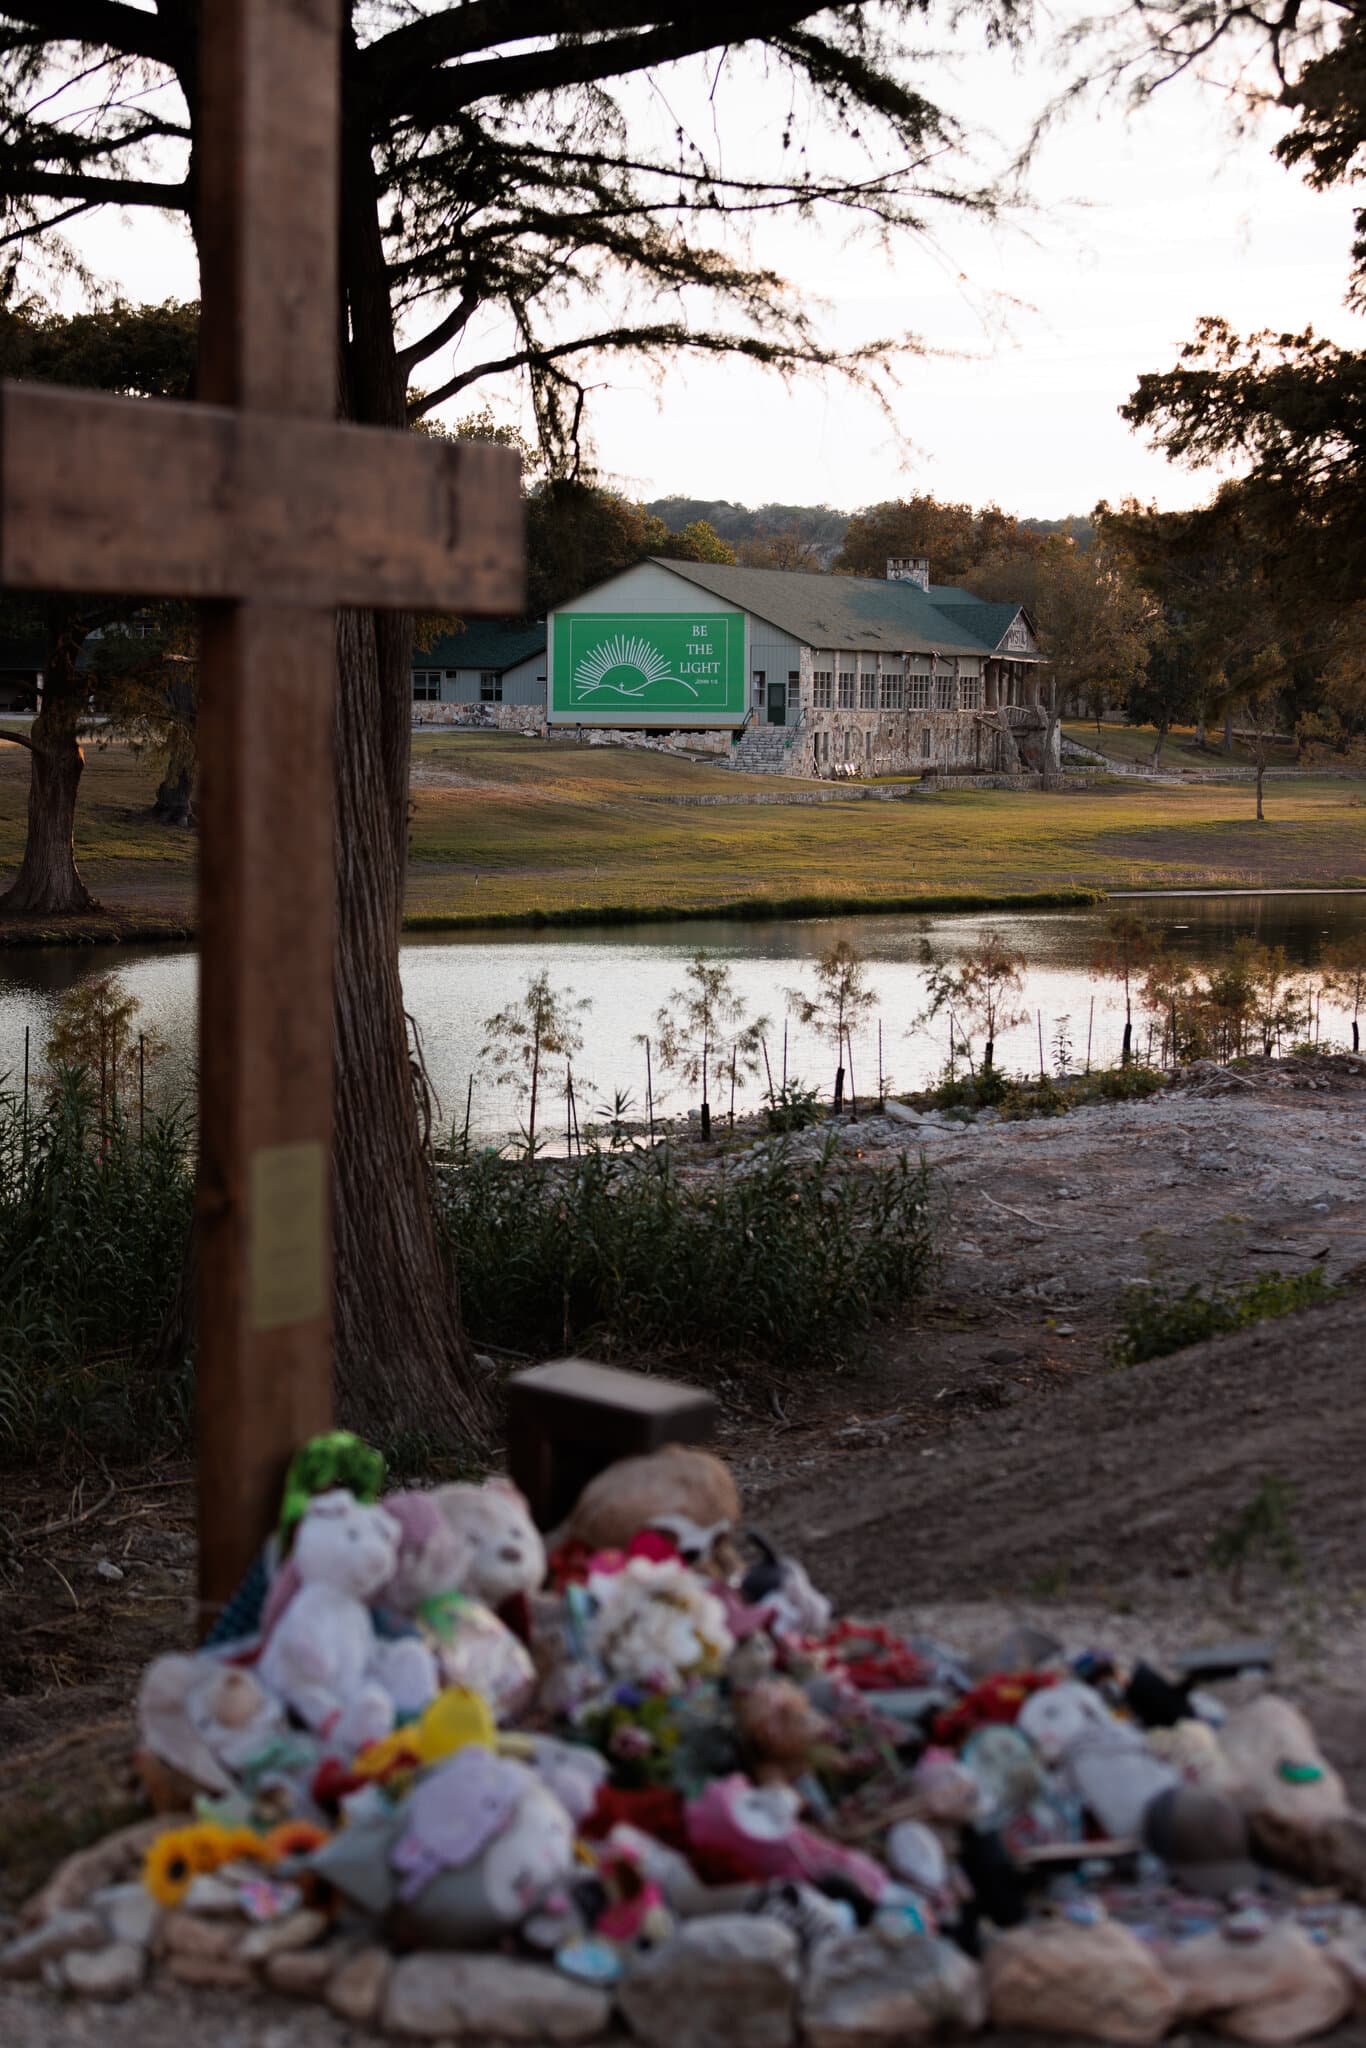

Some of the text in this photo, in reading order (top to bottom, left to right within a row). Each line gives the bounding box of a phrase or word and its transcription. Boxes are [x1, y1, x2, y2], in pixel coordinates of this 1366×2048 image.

[692, 625, 708, 637] BE
[686, 643, 713, 655] THE
[680, 662, 720, 673] LIGHT
